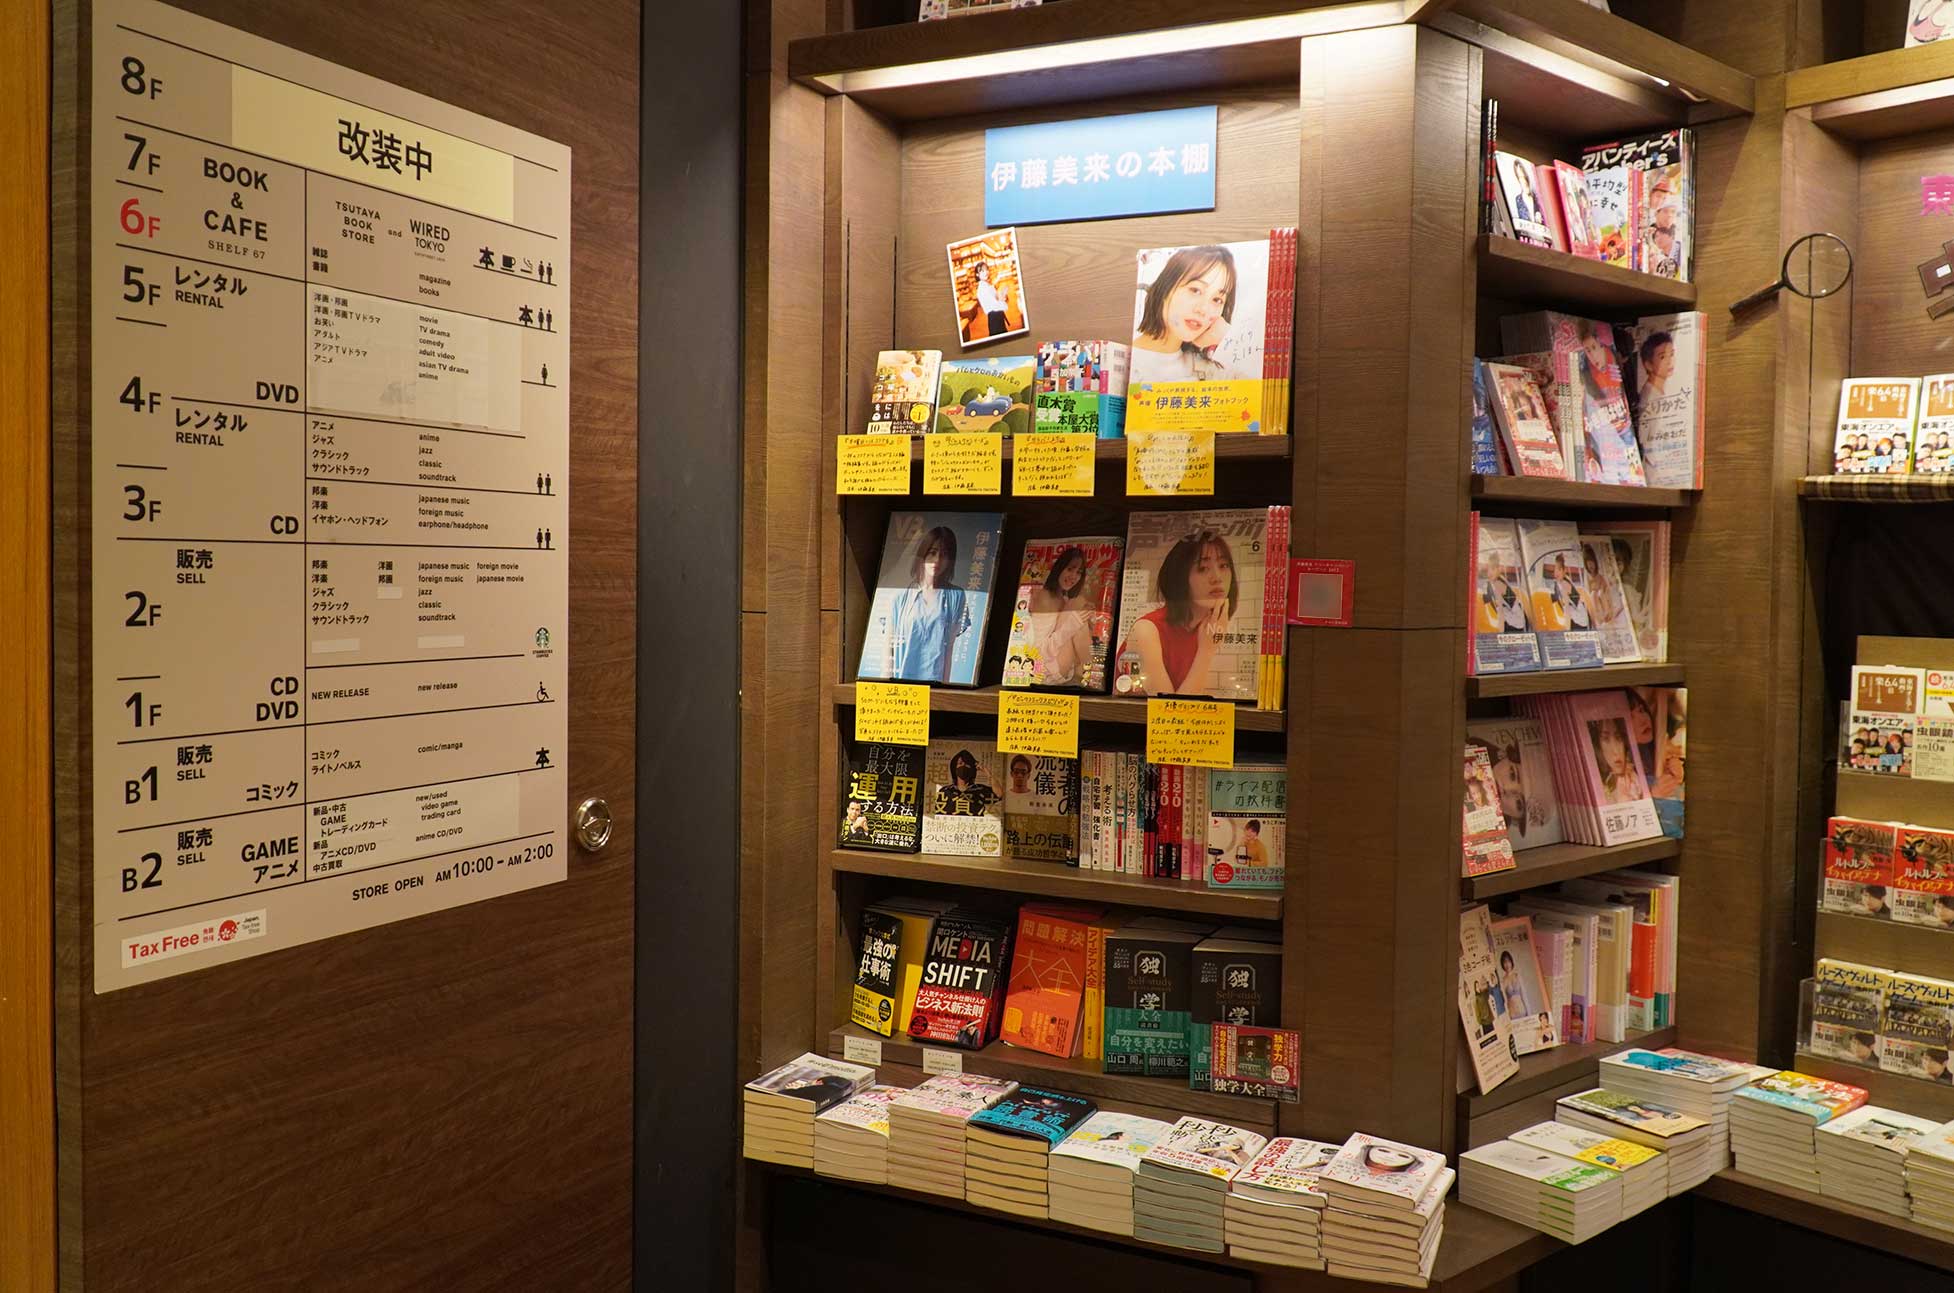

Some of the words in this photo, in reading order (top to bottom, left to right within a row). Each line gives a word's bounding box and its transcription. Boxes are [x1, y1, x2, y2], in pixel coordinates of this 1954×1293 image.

[121, 56, 163, 100] 8F
[124, 133, 161, 175] 7F
[338, 118, 433, 181] 改装中
[1581, 131, 1677, 170] アバンティーズ
[203, 157, 268, 192] BOOK
[991, 142, 1210, 192] 伊藤美来の本棚
[230, 192, 244, 210] &
[120, 198, 161, 238] 6F
[335, 200, 381, 220] TSUTAYA
[203, 209, 268, 242] CAFE
[343, 216, 373, 231] BOOK
[410, 219, 450, 242] WIRED
[341, 229, 375, 244] STORE
[388, 228, 402, 238] and
[207, 240, 249, 256] SHELF
[253, 249, 266, 260] 67
[415, 237, 446, 253] TOKYO
[123, 265, 161, 306] 5F
[175, 266, 247, 295] レンタル
[418, 272, 451, 287] magazine
[418, 285, 440, 297] books
[175, 290, 224, 309] RENTAL
[418, 314, 438, 325] movie
[418, 326, 428, 335] TV
[429, 328, 451, 338] drama
[418, 338, 445, 349] comedy
[313, 354, 334, 364] アニメ
[418, 349, 435, 359] adult
[437, 352, 455, 361] video
[418, 361, 436, 370] asian
[438, 363, 448, 372] TV
[449, 365, 469, 374] drama
[119, 376, 161, 414] 4F
[256, 381, 299, 404] DVD
[1037, 395, 1077, 413] 直木賞
[1155, 395, 1211, 409] 伊藤美来
[175, 408, 248, 432] レンタル
[312, 420, 334, 431] アニメ
[1058, 414, 1099, 426] 本屋大賞
[175, 432, 224, 447] RENTAL
[312, 434, 335, 445] ジャズ
[418, 433, 440, 443] anime
[312, 449, 349, 461] クラシック
[418, 445, 433, 455] jazz
[312, 463, 370, 476] サウンドトラック
[418, 459, 442, 469] classic
[418, 472, 457, 482] soundtrack
[123, 485, 162, 522] 3F
[418, 494, 449, 505] japanese
[450, 496, 470, 505] music
[418, 508, 444, 518] foreign
[445, 509, 464, 518] music
[270, 515, 299, 535] CD
[418, 520, 489, 531] earphone/headphone
[1251, 541, 1260, 552] 6
[176, 549, 213, 569] 販売
[418, 561, 449, 571] japanese
[450, 562, 470, 570] music
[476, 562, 499, 572] foreign
[500, 562, 519, 570] movie
[967, 531, 990, 590] 伊藤美来
[176, 573, 206, 584] SELL
[418, 574, 443, 584] foreign
[444, 575, 464, 584] music
[476, 575, 505, 584] japanese
[506, 575, 524, 583] movie
[312, 587, 335, 597] ジャズ
[418, 587, 432, 597] jazz
[125, 590, 162, 627] 2F
[312, 601, 349, 612] クラシック
[418, 600, 442, 609] classic
[312, 614, 370, 625] サウンドトラック
[418, 613, 456, 622] soundtrack
[1212, 632, 1257, 645] 伊藤美来
[270, 677, 299, 696] CD
[312, 690, 331, 700] NEW
[333, 687, 370, 699] RELEASE
[417, 684, 431, 692] new
[433, 681, 458, 691] release
[125, 692, 162, 727] 1F
[256, 701, 299, 722] DVD
[1852, 715, 1904, 726] 東海オンエア
[1916, 727, 1954, 738] 虫眼鏡
[177, 744, 213, 766] 販売
[312, 750, 340, 760] コミック
[417, 742, 464, 754] comic/manga
[868, 746, 911, 762] 自分を
[177, 768, 206, 781] SELL
[312, 760, 362, 775] ライトノベルス
[865, 759, 908, 777] 最大限
[125, 766, 158, 804] B1
[246, 780, 298, 802] コミック
[848, 772, 918, 804] 運用
[1127, 754, 1138, 818] 脳のバグらせ方
[415, 790, 448, 802] new/used
[1235, 795, 1285, 809] の教科書
[313, 803, 347, 816] 新品・中古
[421, 801, 438, 811] video
[440, 799, 458, 809] game
[860, 800, 914, 817] する方法
[1102, 784, 1113, 827] 考える術
[320, 814, 347, 826] GAME
[421, 810, 445, 821] trading
[446, 808, 462, 817] card
[320, 818, 388, 838] トレーディングカード
[1604, 816, 1638, 833] 佐藤ノア
[177, 827, 213, 850] 販売
[415, 833, 436, 842] anime
[436, 827, 463, 838] CD/DVD
[241, 836, 299, 863] GAME
[313, 840, 329, 851] 新品
[320, 842, 377, 861] アニメCD/DVD
[177, 852, 206, 866] SELL
[121, 852, 162, 893] B2
[253, 859, 299, 884] アニメ
[352, 883, 389, 901] STORE
[394, 875, 424, 892] OPEN
[1022, 919, 1086, 947] 問題解決
[129, 942, 160, 960] Tax
[162, 933, 200, 952] Free
[863, 934, 894, 960] 最強の
[931, 936, 991, 963] MEDIA
[1087, 929, 1098, 989] アイデア大全
[860, 954, 891, 982] 仕事術
[924, 962, 988, 990] SHIFT
[1009, 950, 1082, 997] 大全
[1819, 965, 1883, 985] ルーズヴェルト
[1139, 956, 1161, 1010] 独学
[1887, 979, 1954, 1000] ルーズヴェルト
[915, 996, 985, 1018] ビジネス新法則
[1137, 1010, 1161, 1022] 大全
[1110, 1034, 1189, 1050] 自分を変えたい
[1107, 1054, 1127, 1064] 山口
[1214, 1078, 1266, 1097] 独学大全
